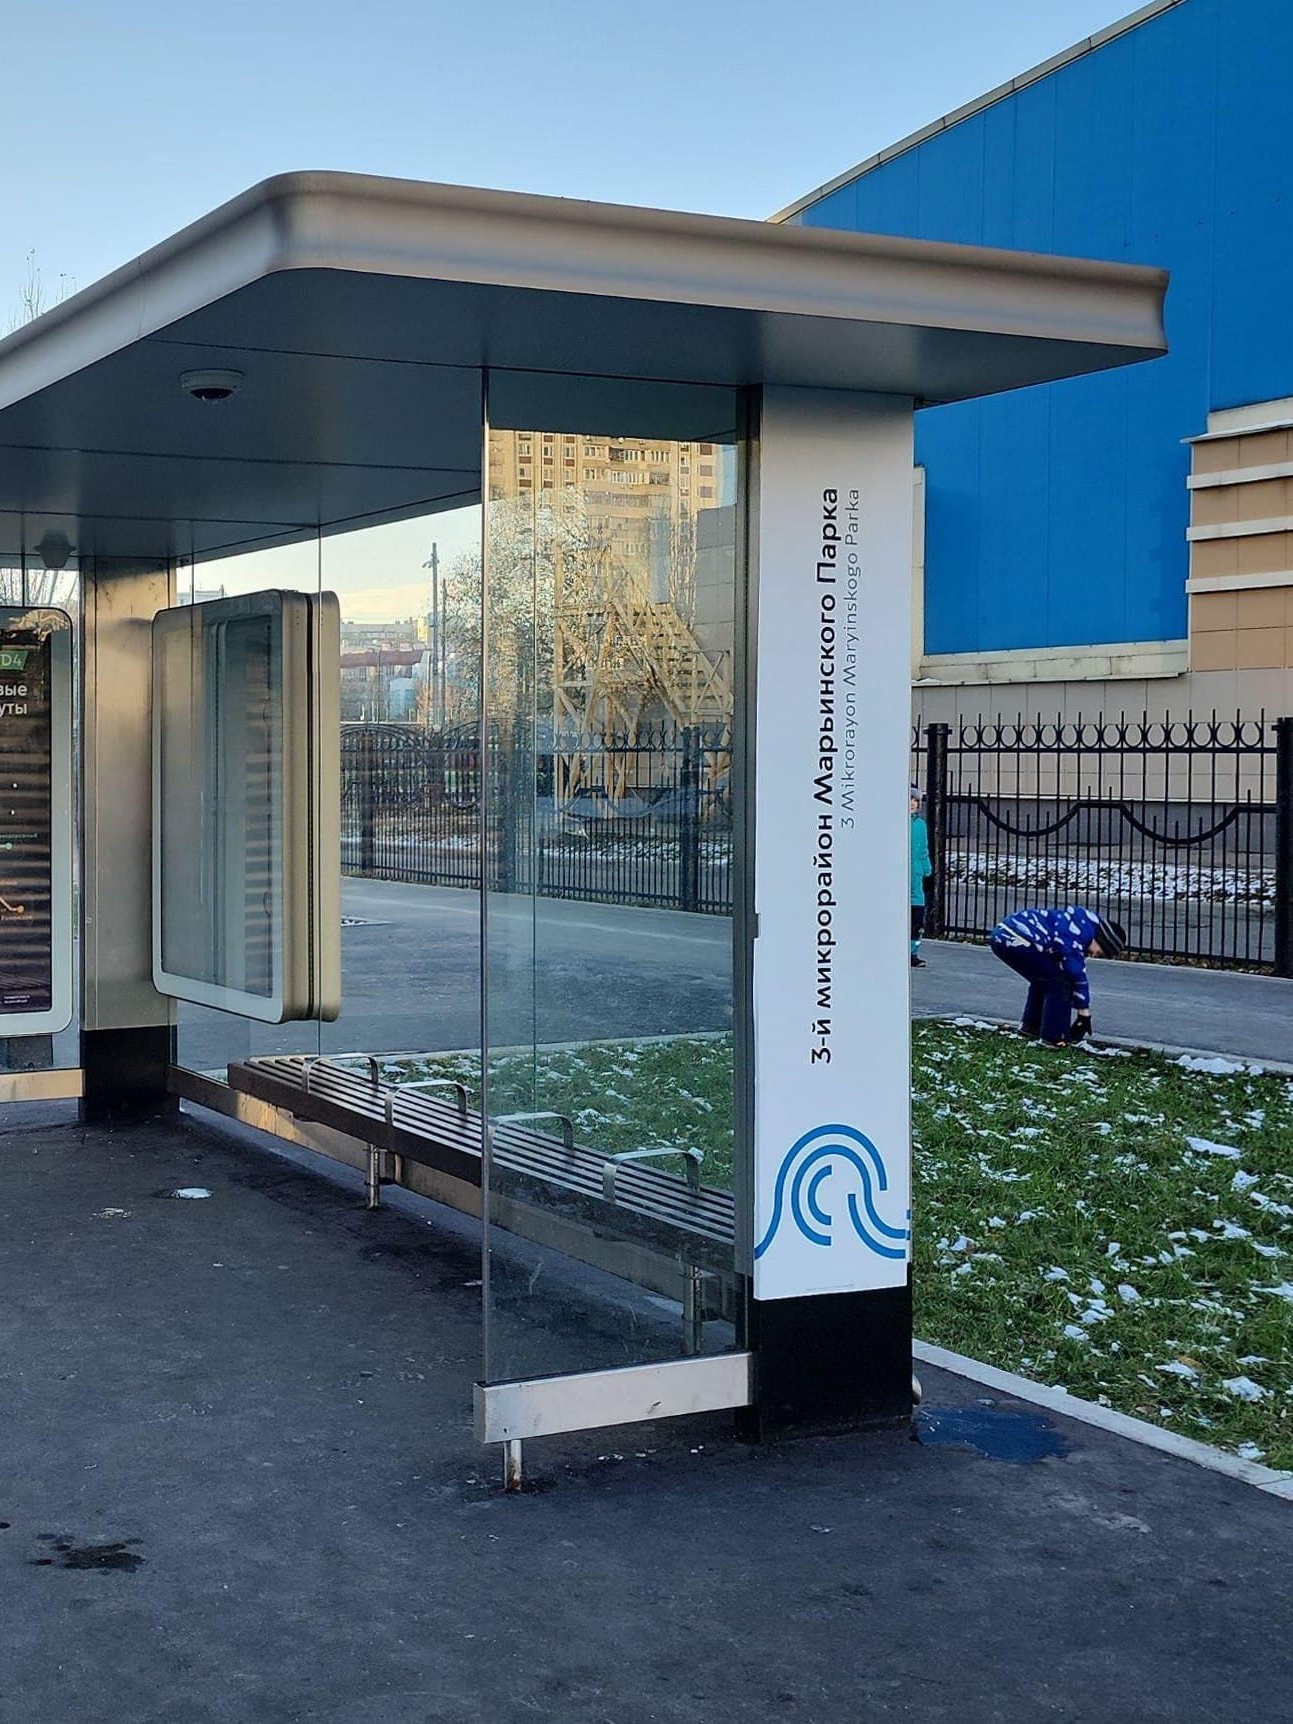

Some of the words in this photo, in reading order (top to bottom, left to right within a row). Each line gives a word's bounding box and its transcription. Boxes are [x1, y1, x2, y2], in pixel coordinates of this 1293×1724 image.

[816, 488, 842, 584] Парка
[845, 489, 859, 546] Parka
[0, 653, 22, 667] D4
[843, 552, 861, 687] Maryinskogo
[813, 593, 838, 806] Марьинского
[841, 692, 858, 812] Mikrorayon
[841, 816, 855, 829] 3
[812, 814, 837, 1009] микрорайон
[810, 1018, 832, 1065] 3-й
